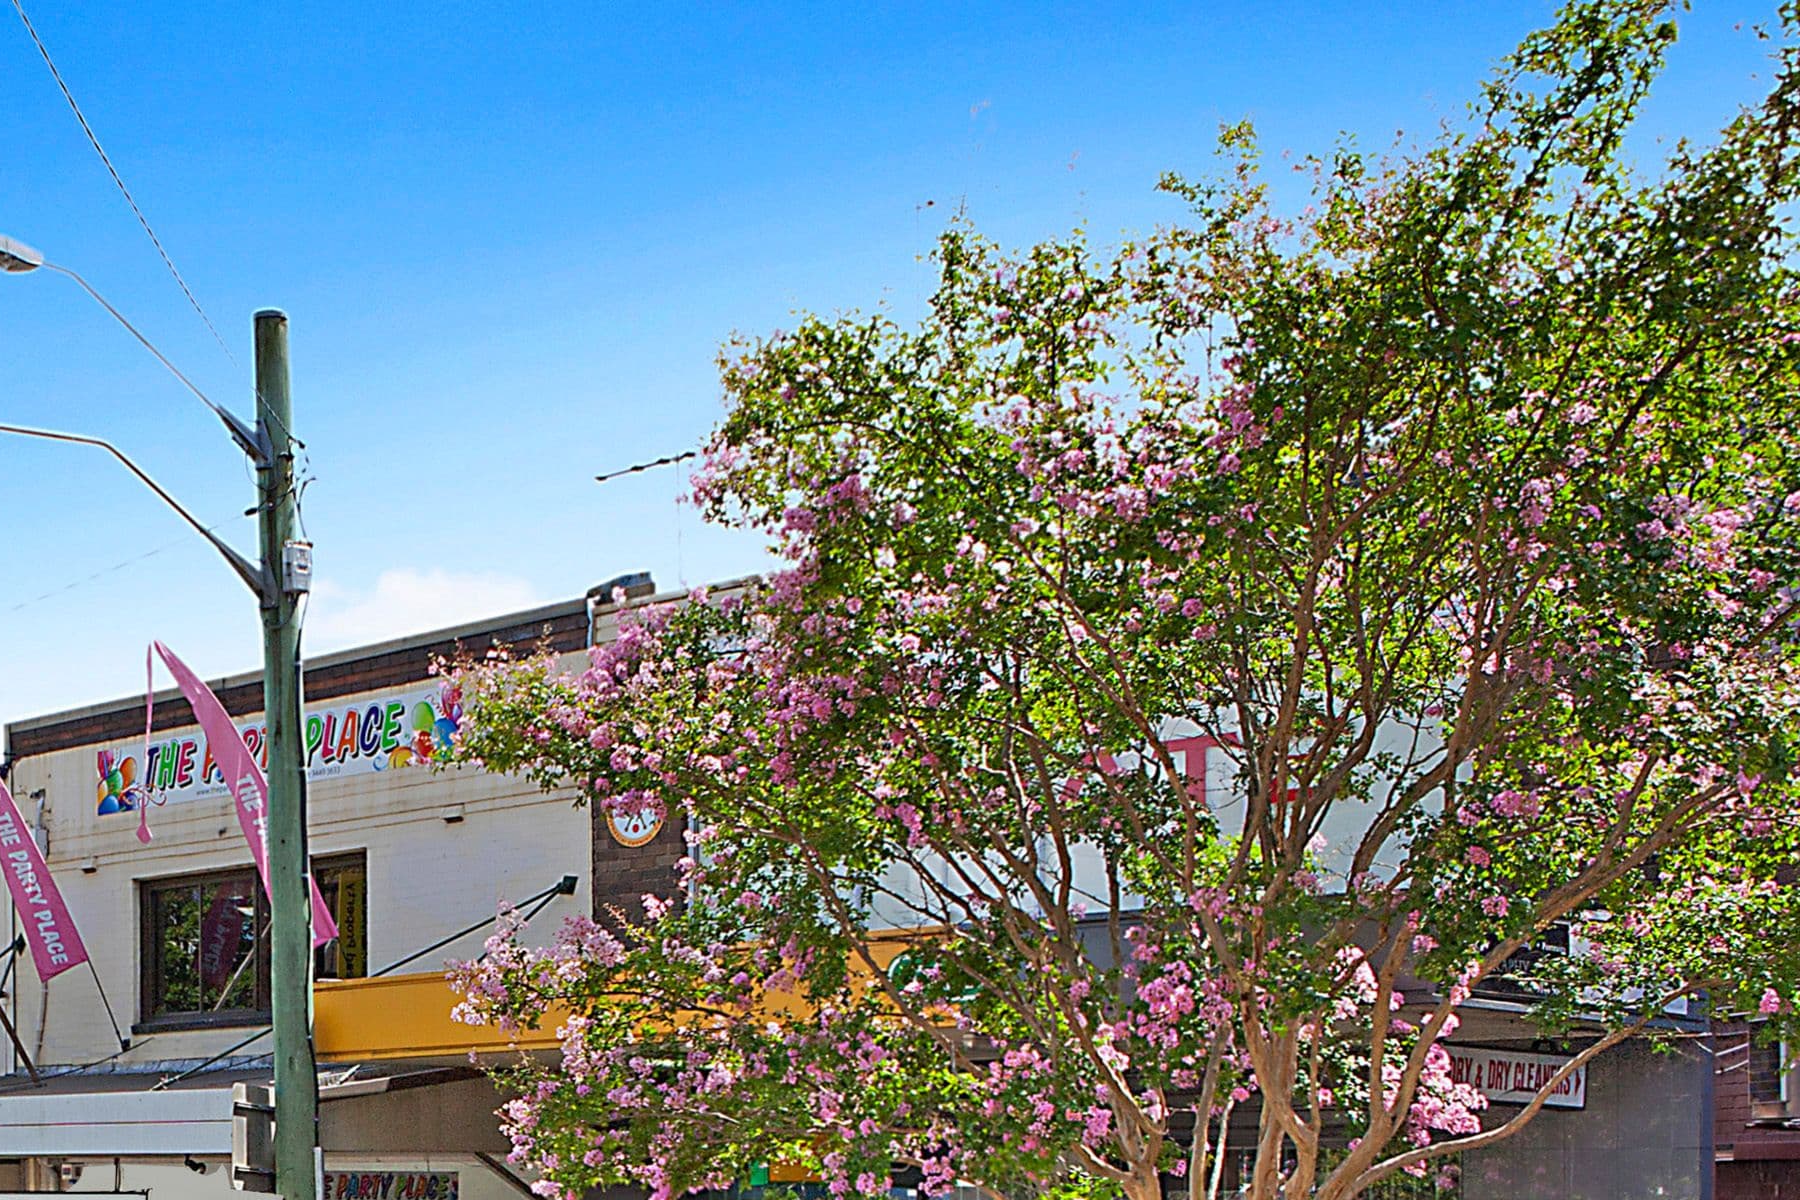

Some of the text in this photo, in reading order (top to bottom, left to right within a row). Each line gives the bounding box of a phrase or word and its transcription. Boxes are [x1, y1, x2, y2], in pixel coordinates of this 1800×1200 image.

[146, 741, 197, 791] THE
[302, 702, 404, 767] PLACE
[237, 773, 264, 812] THE
[8, 850, 48, 905] PARTY
[34, 909, 69, 965] PLACE
[1487, 1060, 1512, 1091] DRY
[335, 1172, 393, 1200] PARTY
[395, 1172, 450, 1200] PLACE
